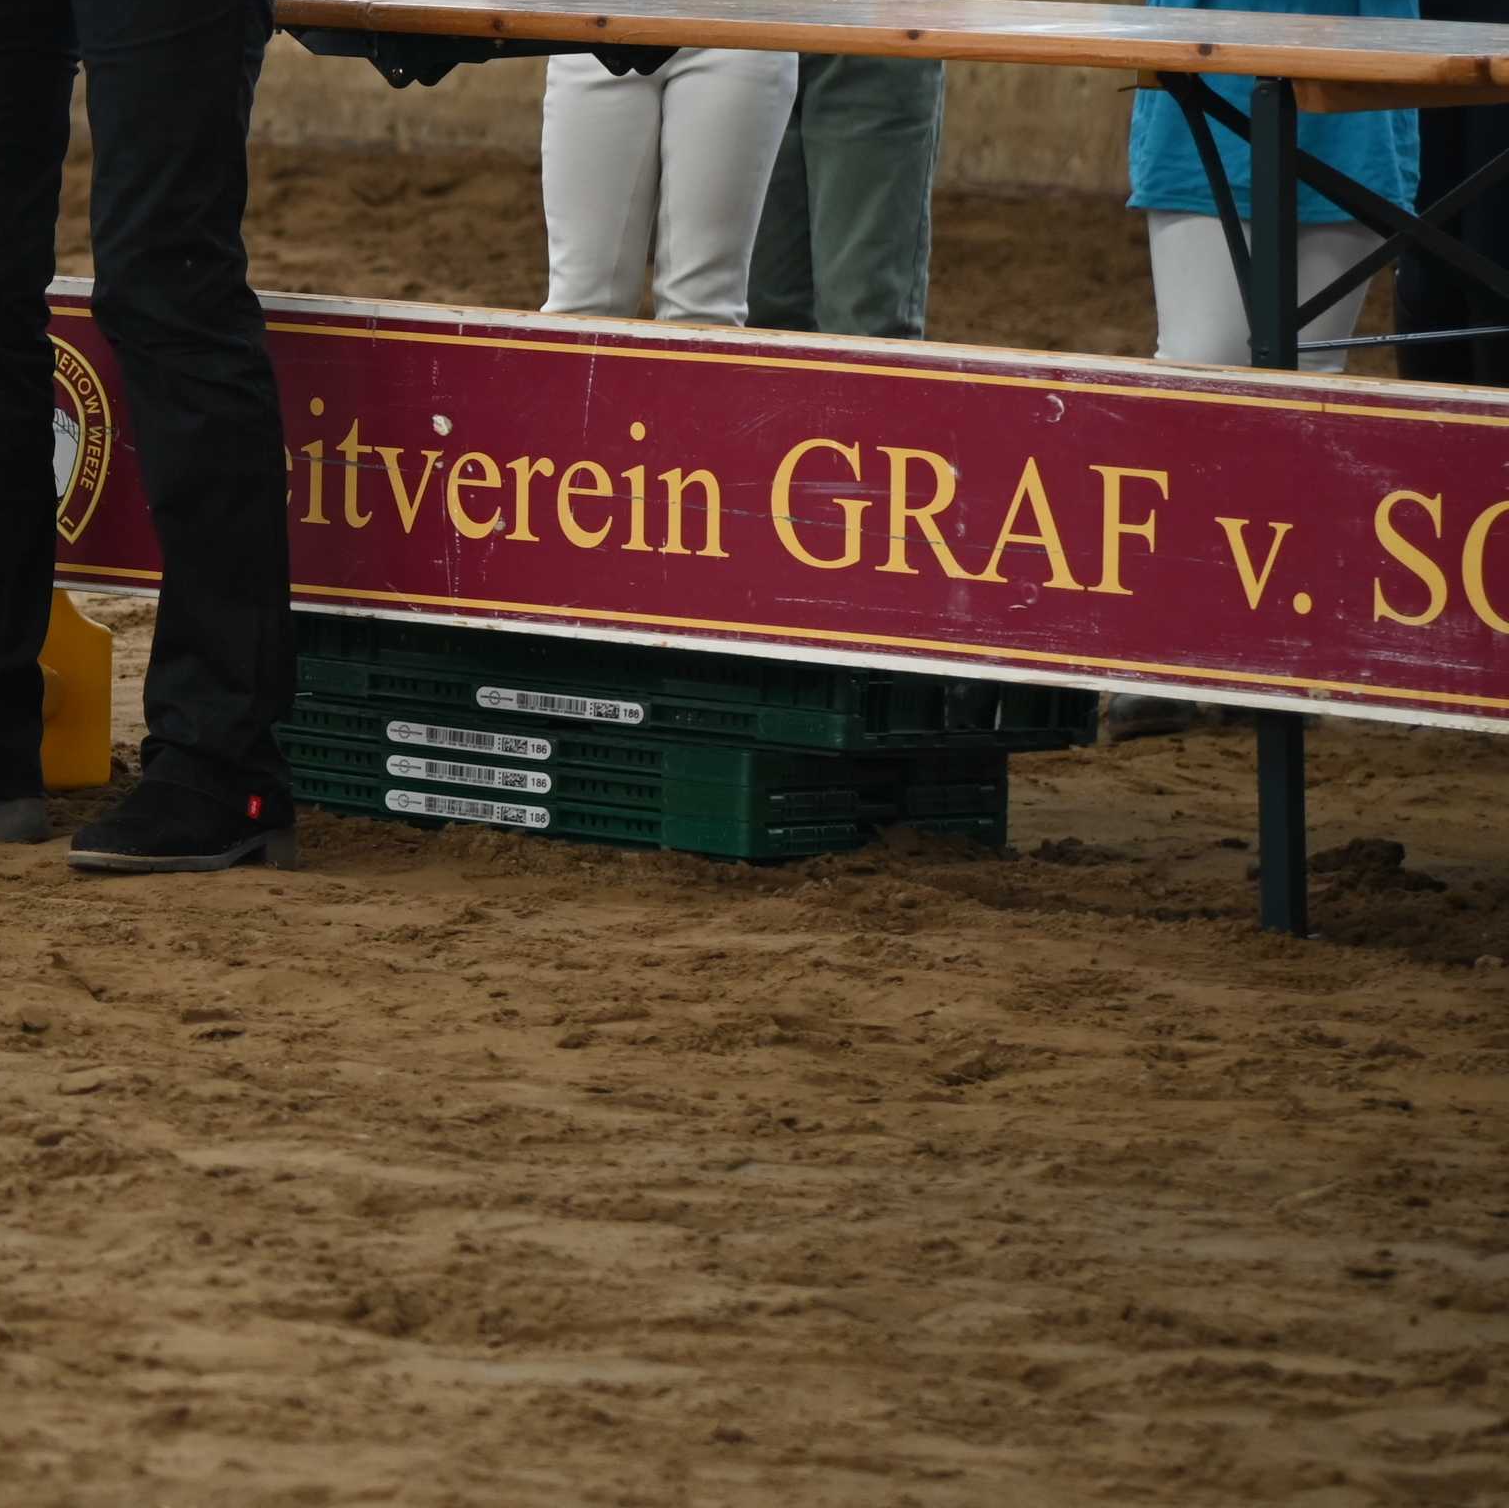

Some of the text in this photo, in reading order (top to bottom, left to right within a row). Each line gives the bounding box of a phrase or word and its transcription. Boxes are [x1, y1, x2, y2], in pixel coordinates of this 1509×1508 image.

[80, 425, 102, 492] WEEZE
[284, 397, 730, 559] itverein
[769, 437, 1170, 597] GRAF
[1213, 515, 1313, 616] v.
[530, 743, 548, 755] 186
[530, 777, 548, 789] 186
[529, 811, 547, 824] 186
